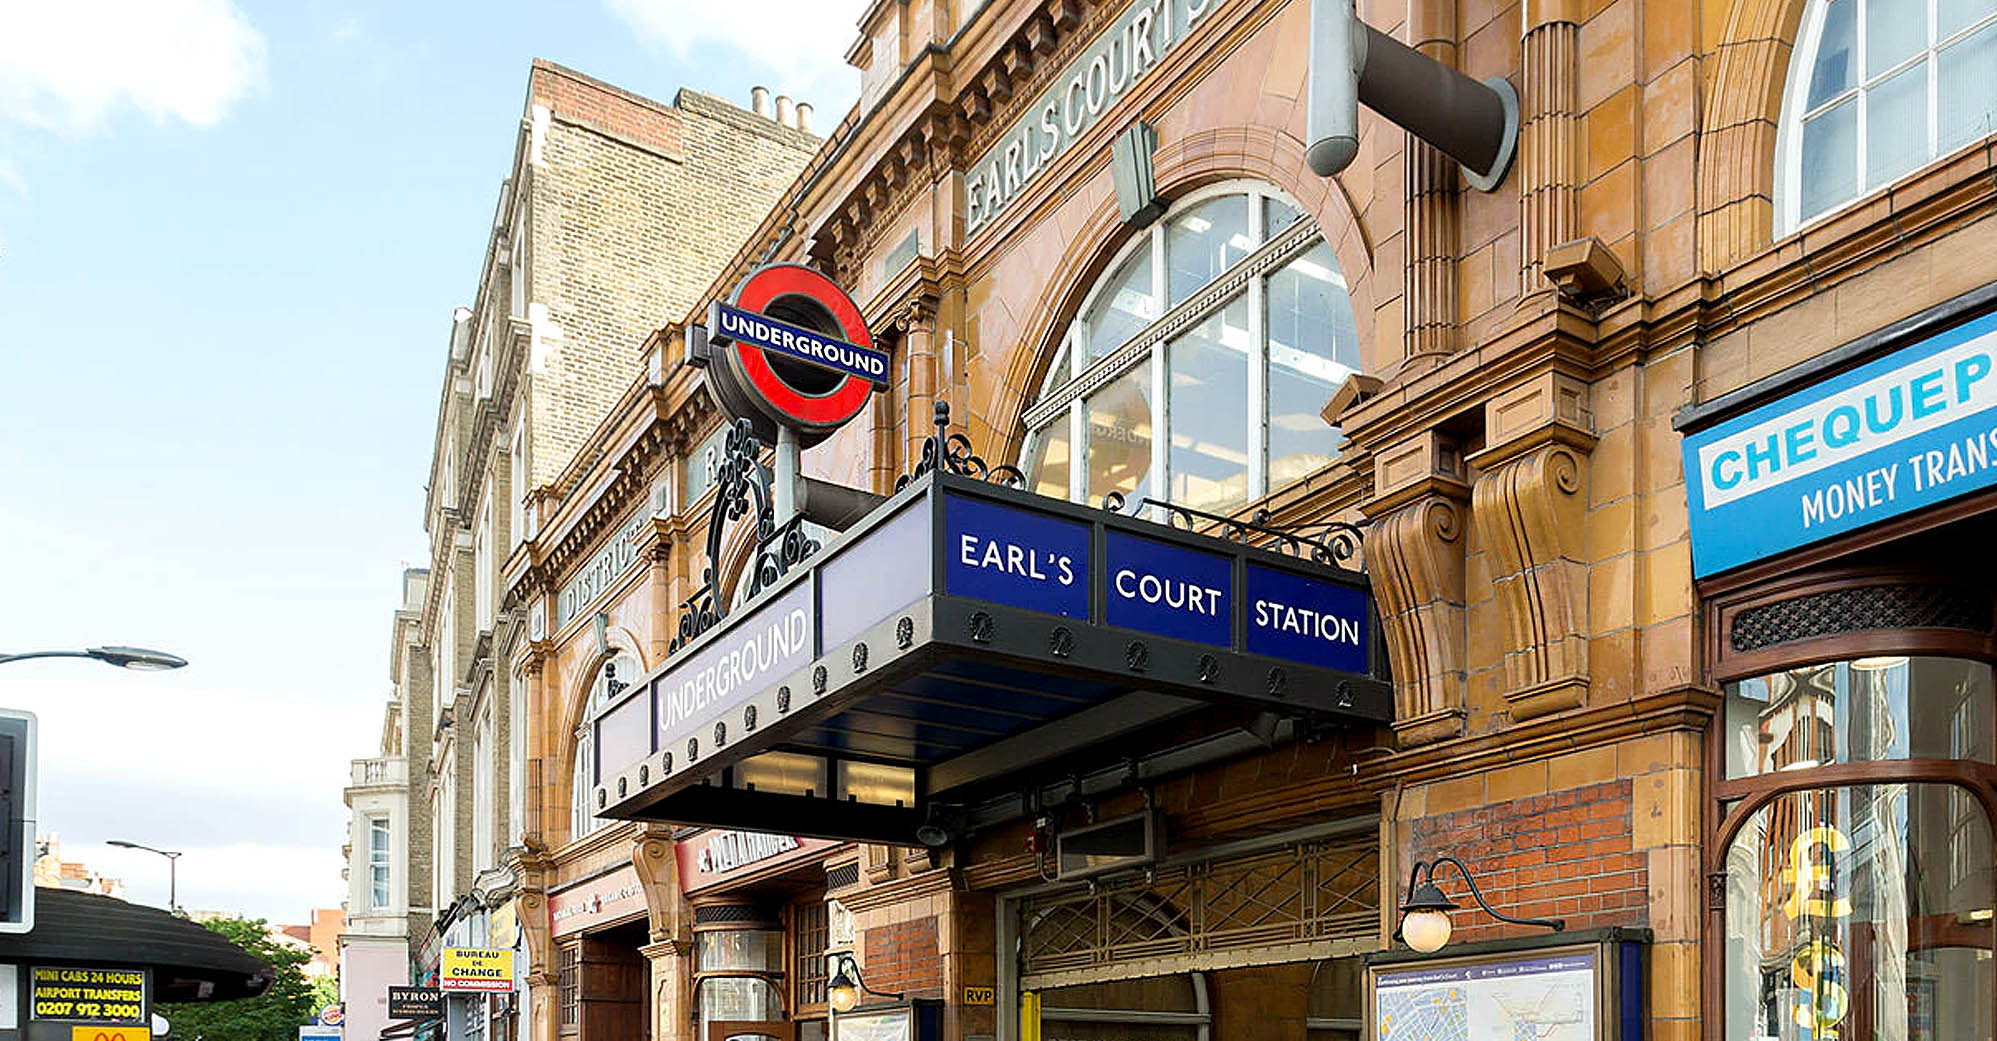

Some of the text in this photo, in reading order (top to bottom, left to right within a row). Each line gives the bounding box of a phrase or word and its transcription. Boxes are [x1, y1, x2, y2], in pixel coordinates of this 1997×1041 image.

[966, 101, 1061, 230] EARLS
[721, 312, 884, 375] UNDERGROUND
[1711, 353, 1993, 491] CHEQUEP
[1801, 464, 1898, 529] MONEY
[960, 534, 1359, 646] EARL'S COURT STATION
[659, 609, 806, 731] UNDERGROUND
[455, 950, 500, 959] BUREAU
[35, 969, 142, 985] MINI CABS 24 HOURS
[452, 967, 502, 977] CHANGE
[443, 979, 456, 987] NO
[35, 987, 141, 1002] AIRPORT TRANSFERS
[392, 991, 438, 1002] BYRON
[967, 990, 992, 1002] RVP
[36, 1002, 140, 1018] 0207 912 3000
